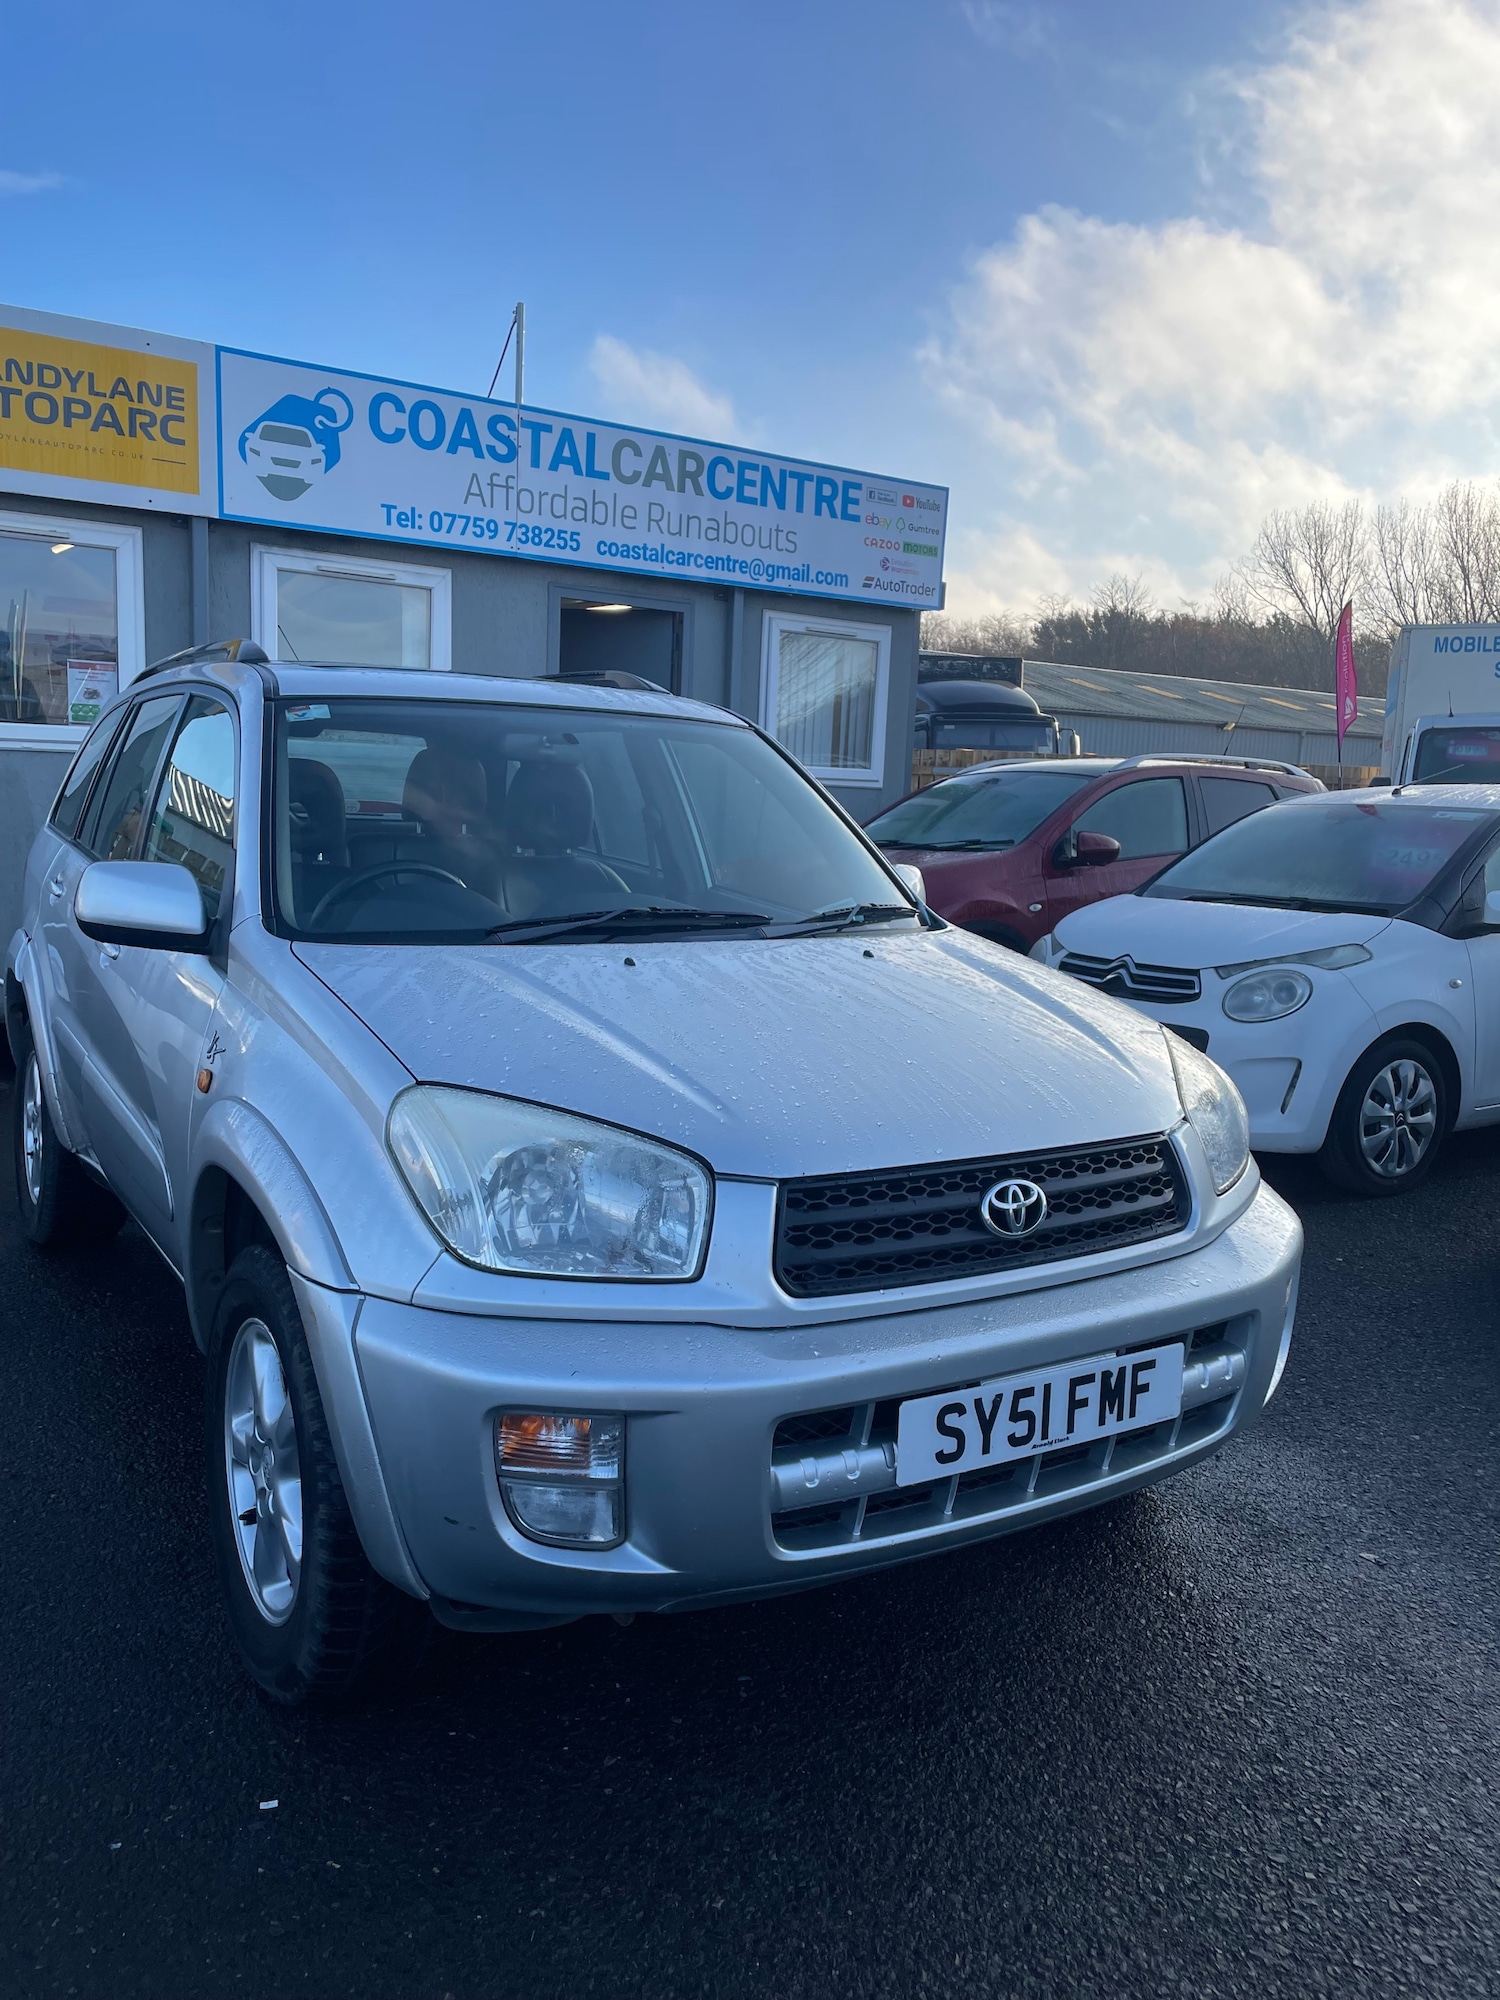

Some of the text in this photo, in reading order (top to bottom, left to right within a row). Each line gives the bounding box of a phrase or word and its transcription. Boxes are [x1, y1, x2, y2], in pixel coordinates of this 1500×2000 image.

[0, 357, 185, 412] NDYLANE
[0, 385, 186, 446] TOPARC
[463, 472, 797, 554] Affordable Runabouts
[865, 512, 892, 530] ebay
[915, 496, 941, 512] YouTube
[380, 503, 581, 552] Tel: 07759 738255
[863, 536, 901, 551] CAZOO
[908, 523, 940, 536] Gumtree
[596, 540, 849, 588] coastalcarcentre@gmail.com
[873, 577, 937, 597] AutoTrader
[1434, 636, 1500, 653] MOBILE
[934, 1358, 1157, 1465] SY51 FMF
